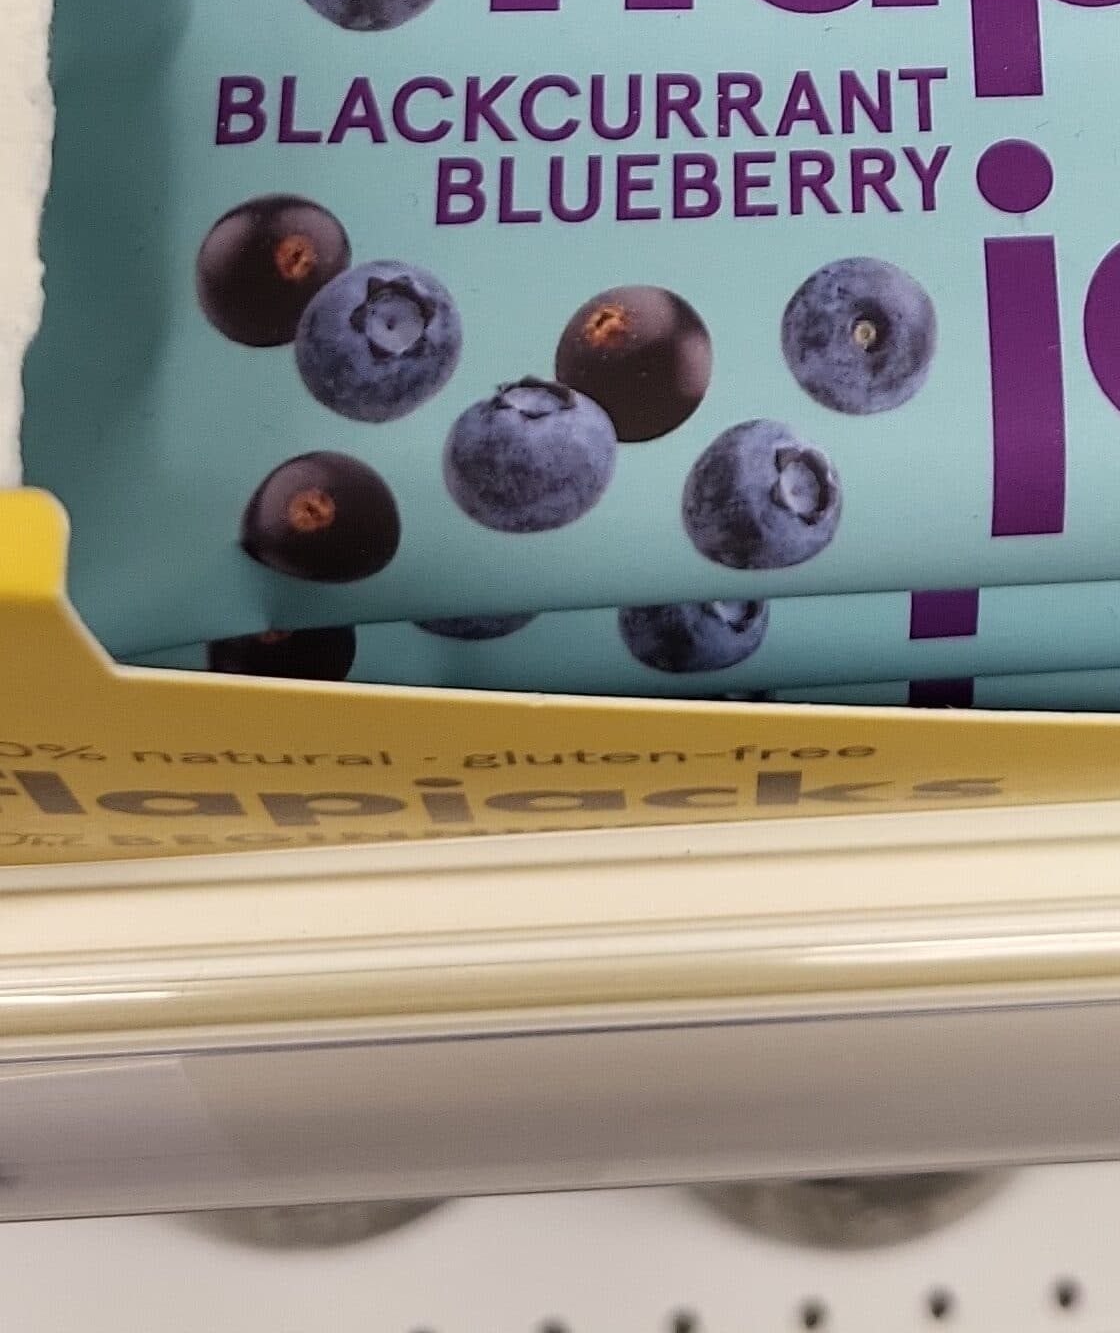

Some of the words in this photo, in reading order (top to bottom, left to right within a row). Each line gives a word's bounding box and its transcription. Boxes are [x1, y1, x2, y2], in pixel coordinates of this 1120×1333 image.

[214, 66, 948, 146] BLACKCURRANT
[434, 144, 951, 226] BLUEBERRY
[132, 749, 393, 766] natural
[463, 745, 876, 769] gluten-free
[0, 768, 1005, 827] lapjacks
